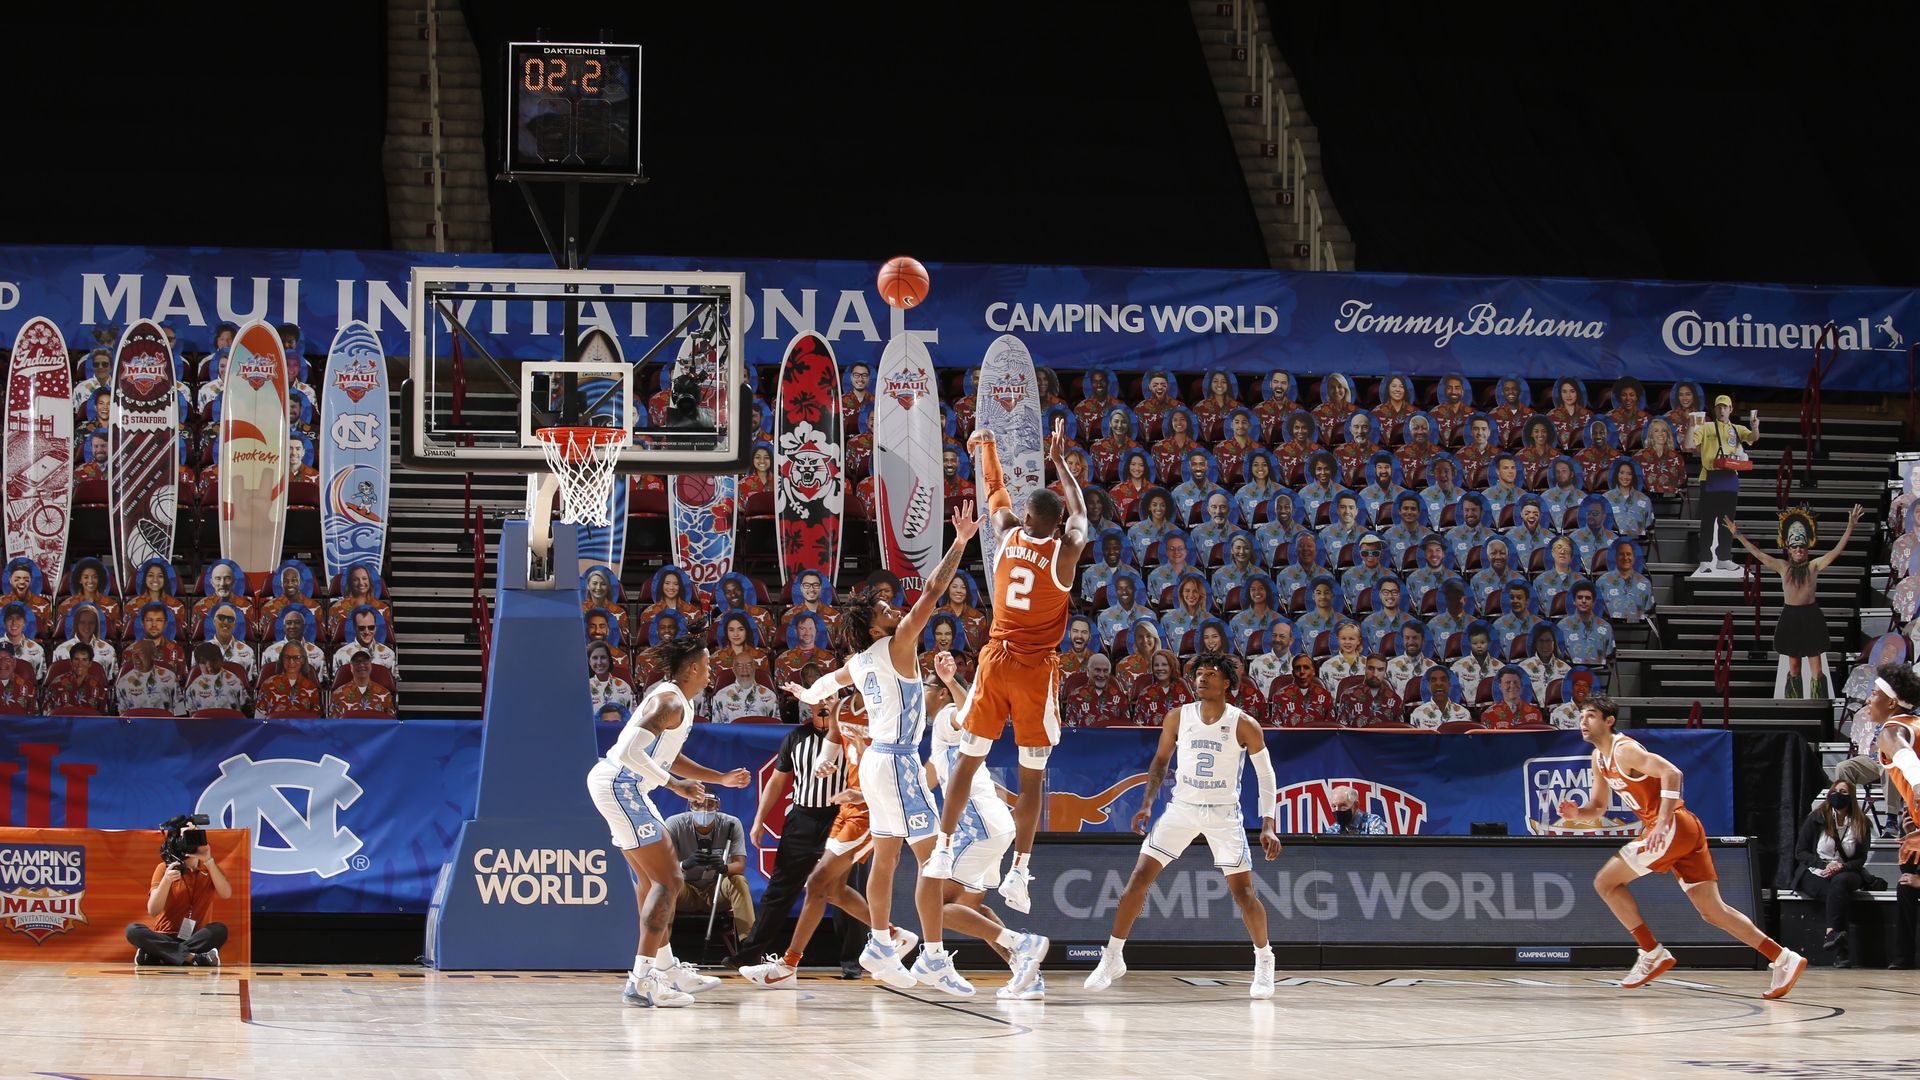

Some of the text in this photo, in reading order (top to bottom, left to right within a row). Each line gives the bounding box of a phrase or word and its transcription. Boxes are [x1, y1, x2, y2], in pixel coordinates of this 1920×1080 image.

[543, 47, 607, 55] DAKTRONICS
[80, 273, 302, 327] MAUI
[985, 302, 1279, 334] CAMPING WORLD
[1334, 299, 1605, 348] Tommy Bahama
[1661, 309, 1873, 356] Continental
[14, 348, 66, 372] Indiana
[242, 365, 273, 374] MAUI
[127, 366, 163, 375] MAUI
[338, 373, 375, 383] MAUI
[889, 381, 924, 390] MAUI
[993, 386, 1024, 394] MAUI
[131, 416, 167, 425] STANFORD
[423, 449, 456, 457] SPALDING
[1005, 545, 1050, 570] COLEMAN III
[1005, 565, 1036, 611] 2
[863, 671, 883, 705] 4
[1190, 739, 1223, 752] NORTH
[1195, 752, 1215, 778] 2
[1182, 774, 1228, 790] CAROLINA
[1534, 768, 1594, 790] CAMP
[0, 849, 81, 867] CAMPING
[474, 848, 607, 874] CAMPING
[0, 865, 82, 885] WORLD
[474, 873, 608, 905] WORLD
[1347, 869, 1576, 922] WORLD
[3, 896, 77, 915] MAUI
[17, 914, 63, 925] INVITATIONAL
[1068, 949, 1098, 957] CAMPING
